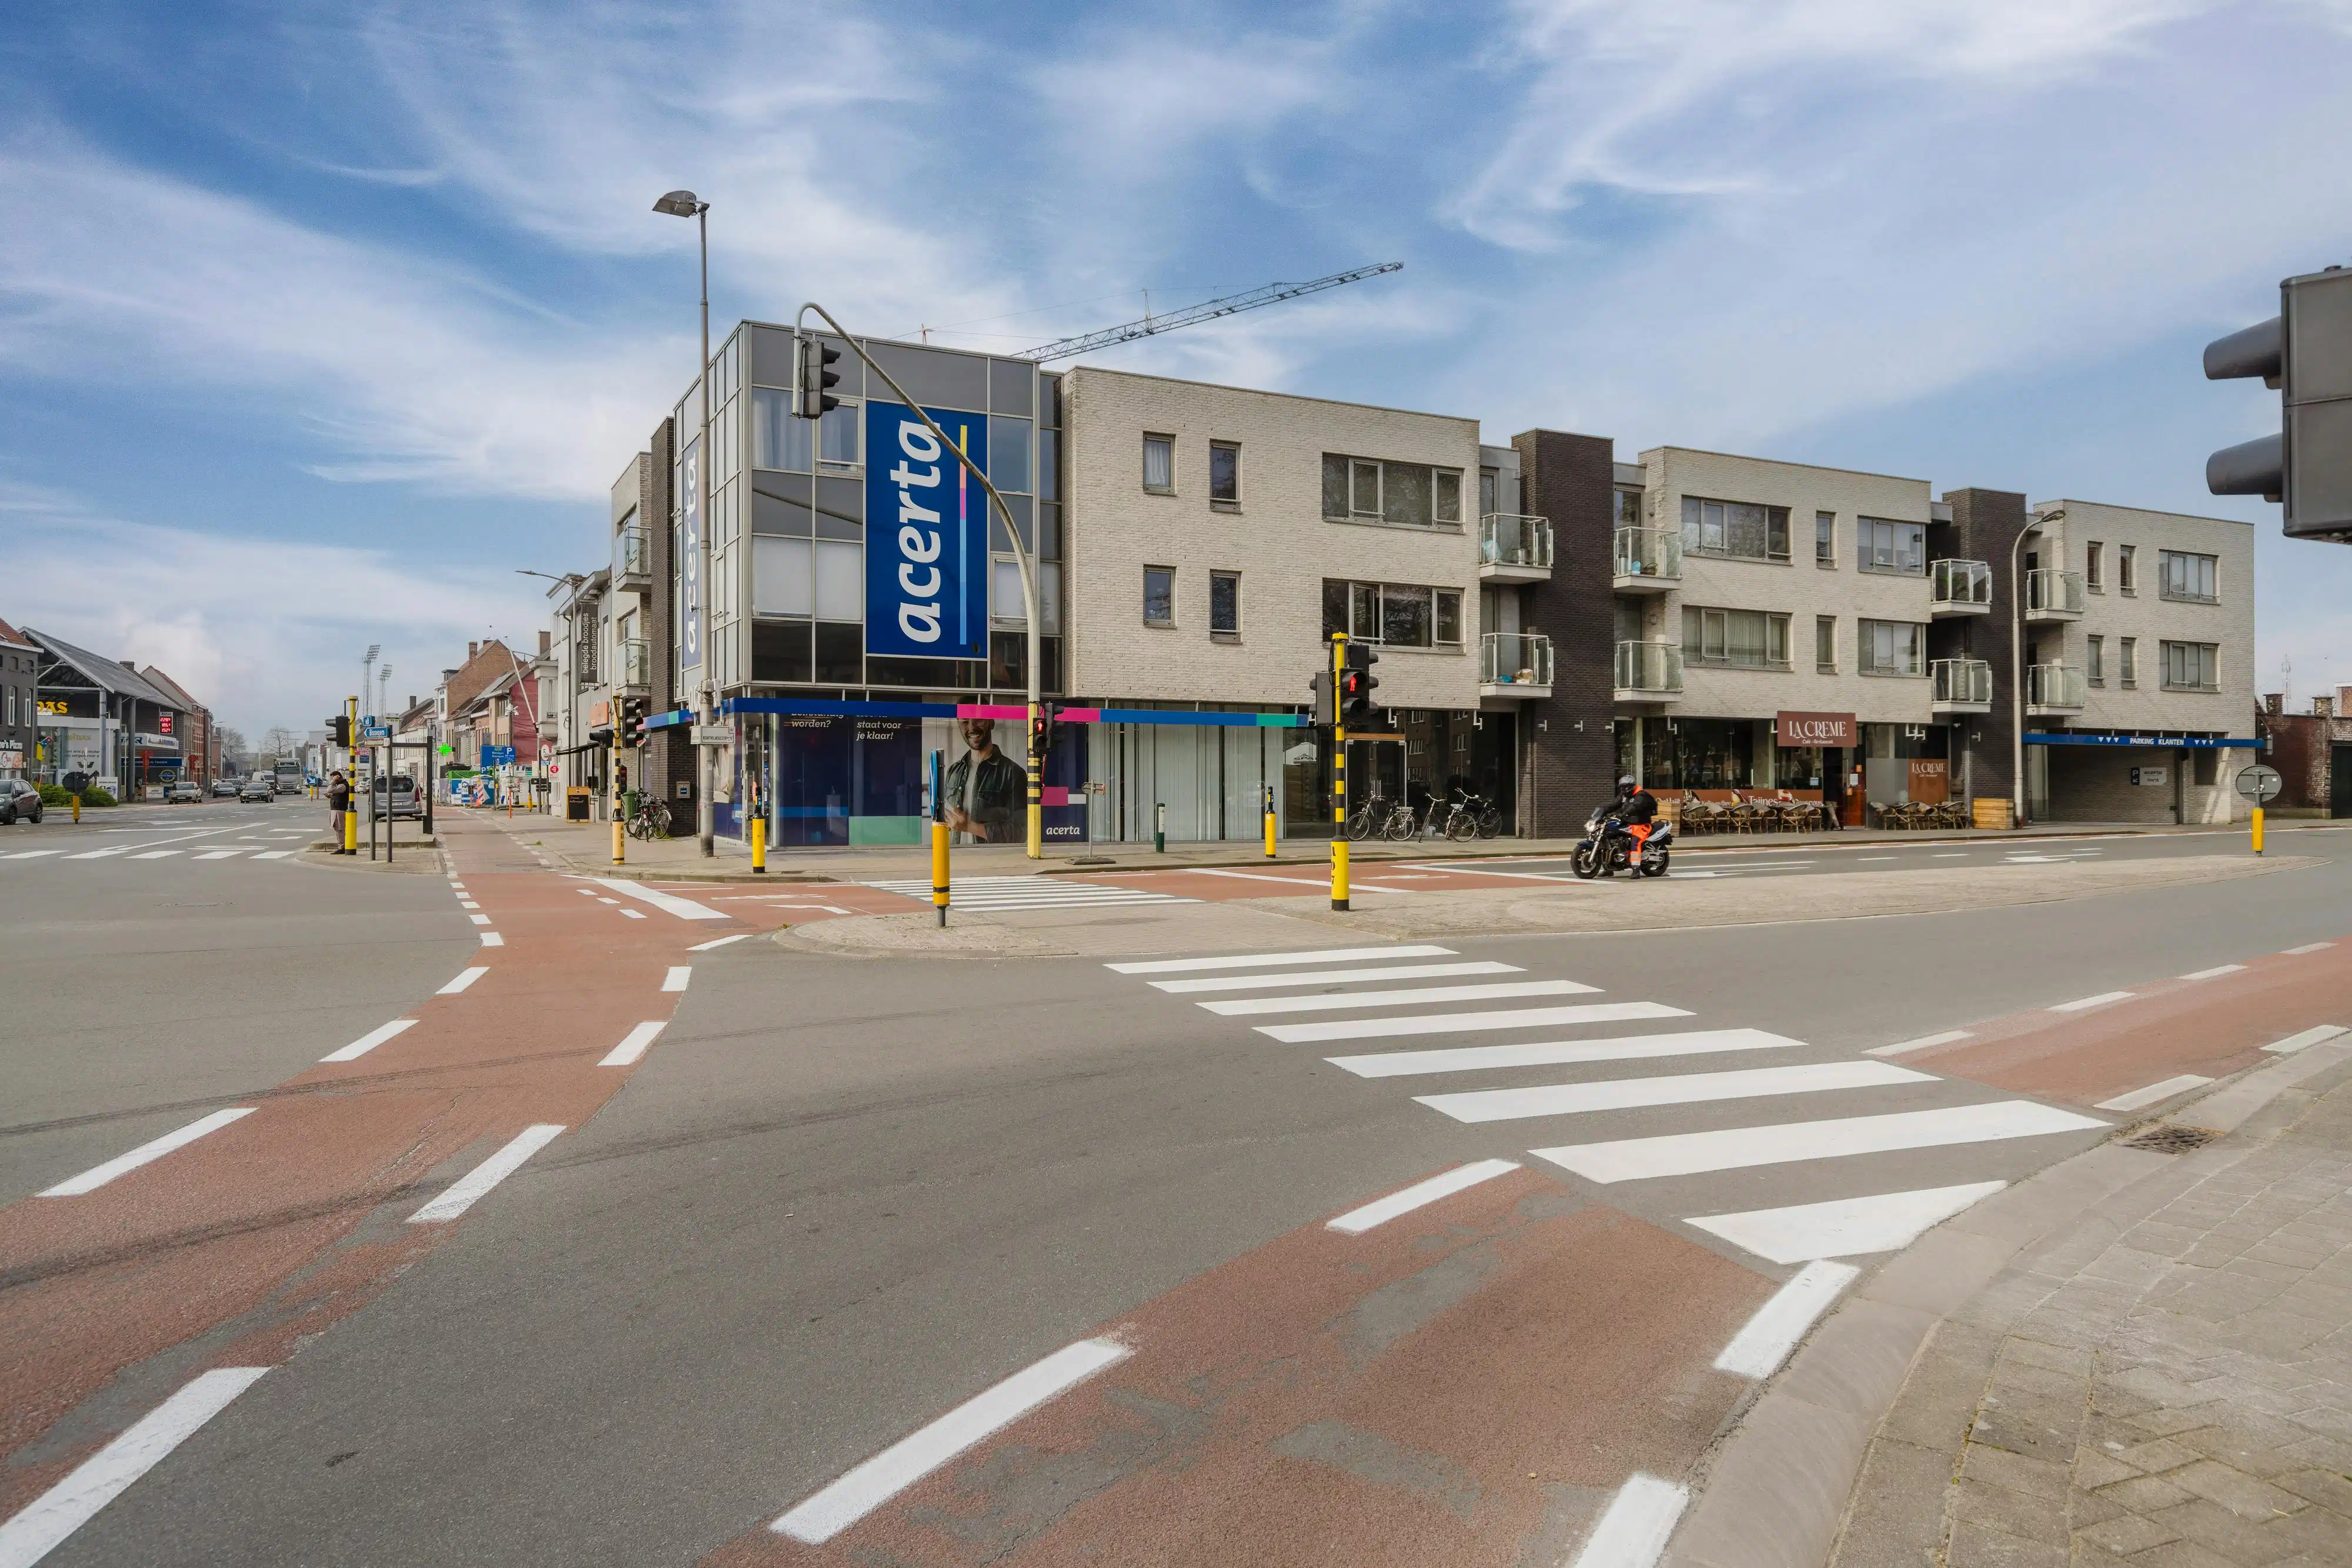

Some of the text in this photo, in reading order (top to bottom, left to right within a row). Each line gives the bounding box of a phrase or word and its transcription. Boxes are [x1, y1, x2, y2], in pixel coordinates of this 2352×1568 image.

[889, 419, 941, 643] acerta
[686, 453, 696, 654] acerta
[582, 613, 590, 673] belegde broodjes
[37, 701, 68, 714] DAS
[791, 720, 831, 728] worden?
[1789, 721, 1847, 738] LA CREME
[856, 731, 894, 741] je klaar!
[1912, 763, 1946, 774] LA CREME
[1046, 825, 1080, 835] acerta
